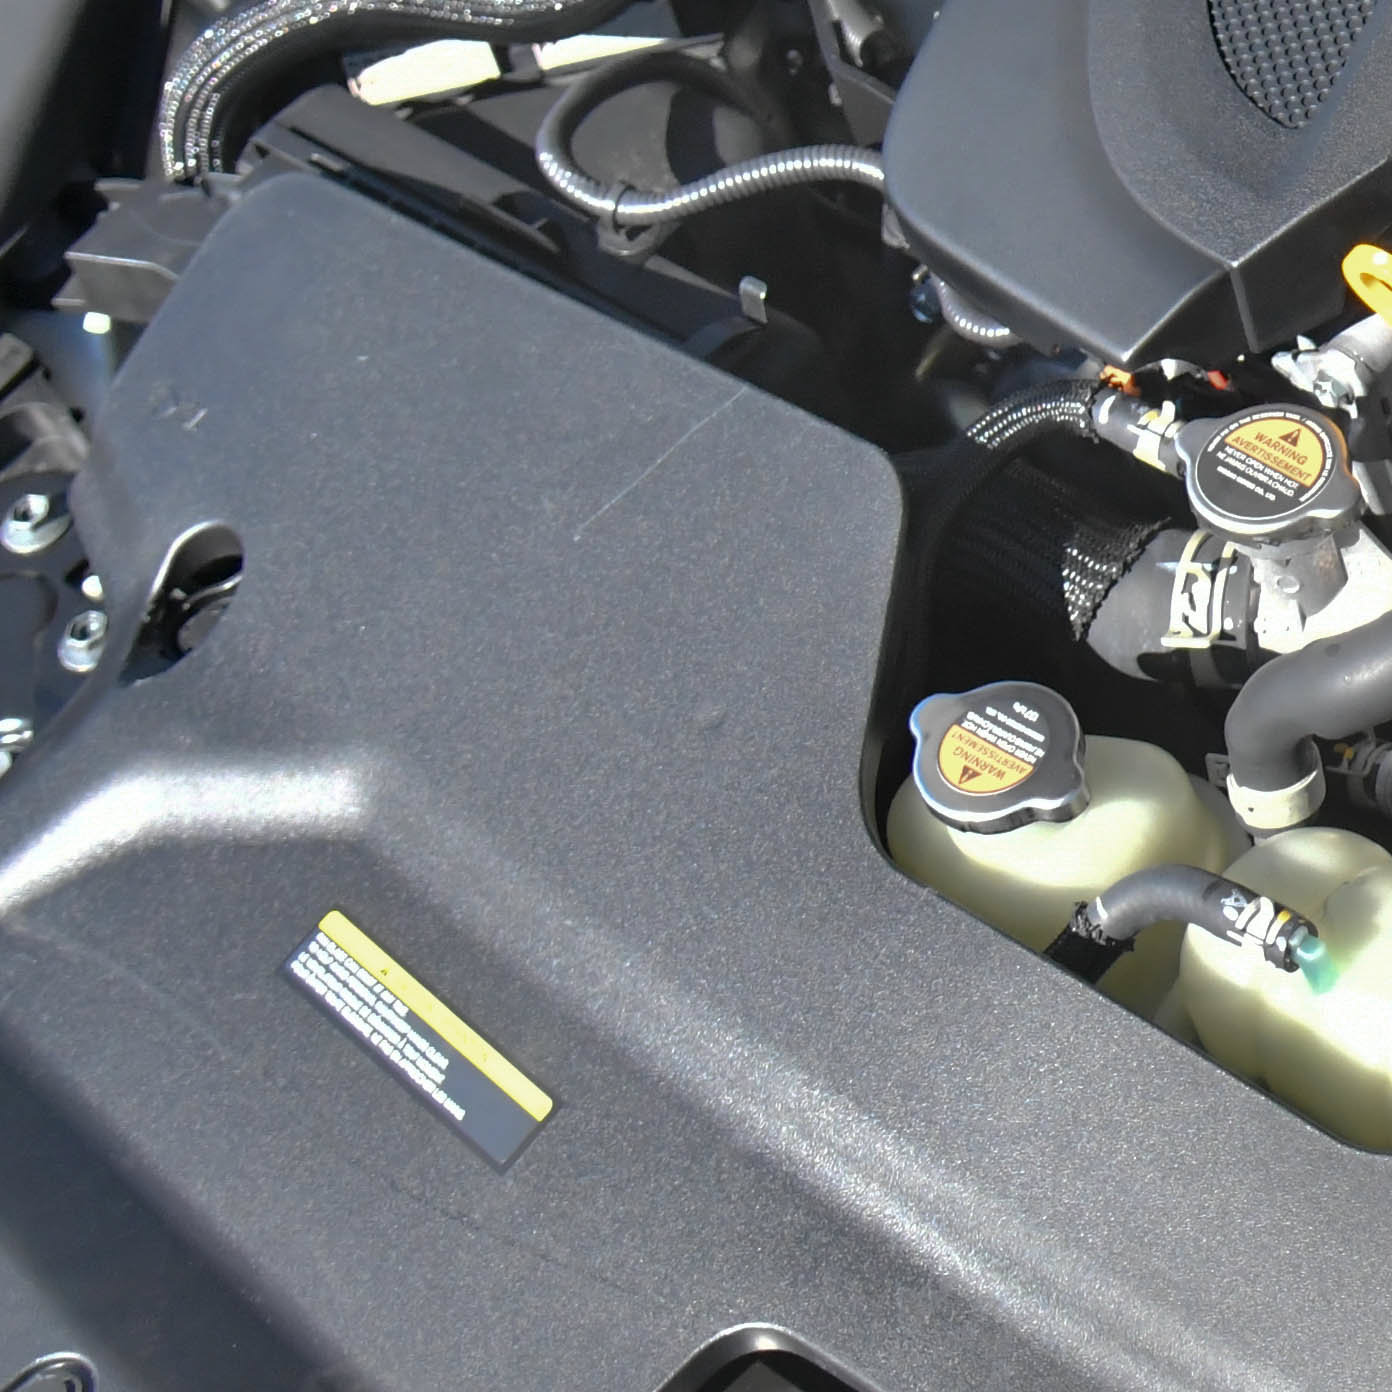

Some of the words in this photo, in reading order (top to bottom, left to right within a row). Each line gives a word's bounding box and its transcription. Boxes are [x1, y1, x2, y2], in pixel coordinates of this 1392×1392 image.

[1232, 436, 1311, 480] AVERTISSEMENT
[1255, 432, 1308, 465] WARNING
[952, 733, 1027, 774] AVERTISSEMENT
[953, 746, 1006, 780] WARNING
